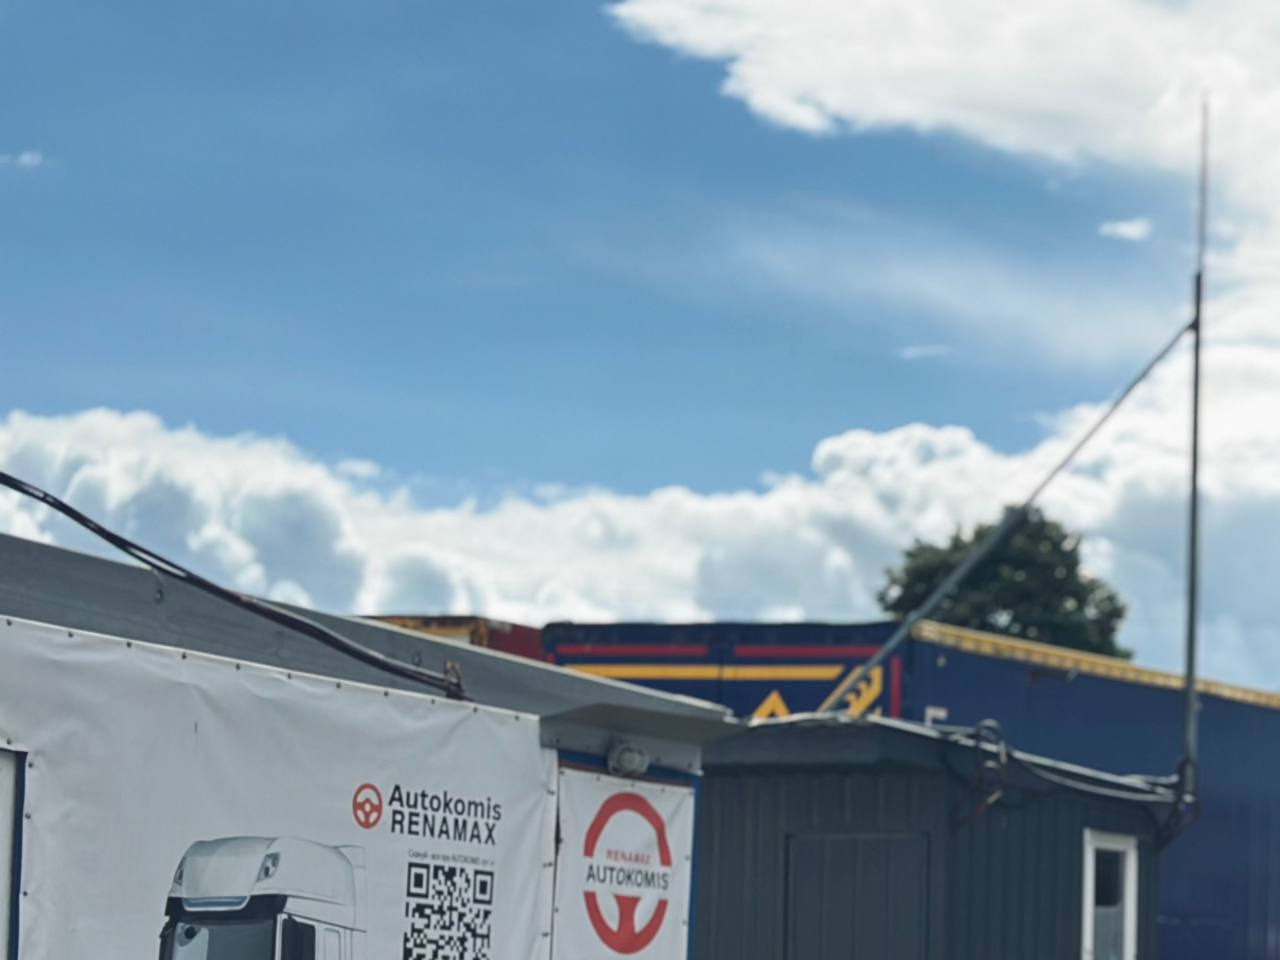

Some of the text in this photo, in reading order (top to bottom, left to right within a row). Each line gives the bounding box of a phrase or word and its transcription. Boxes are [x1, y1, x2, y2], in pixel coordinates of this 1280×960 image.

[388, 784, 501, 821] Autokomis
[391, 810, 496, 846] RENAMAX
[586, 864, 669, 890] AUTOKOMIS
